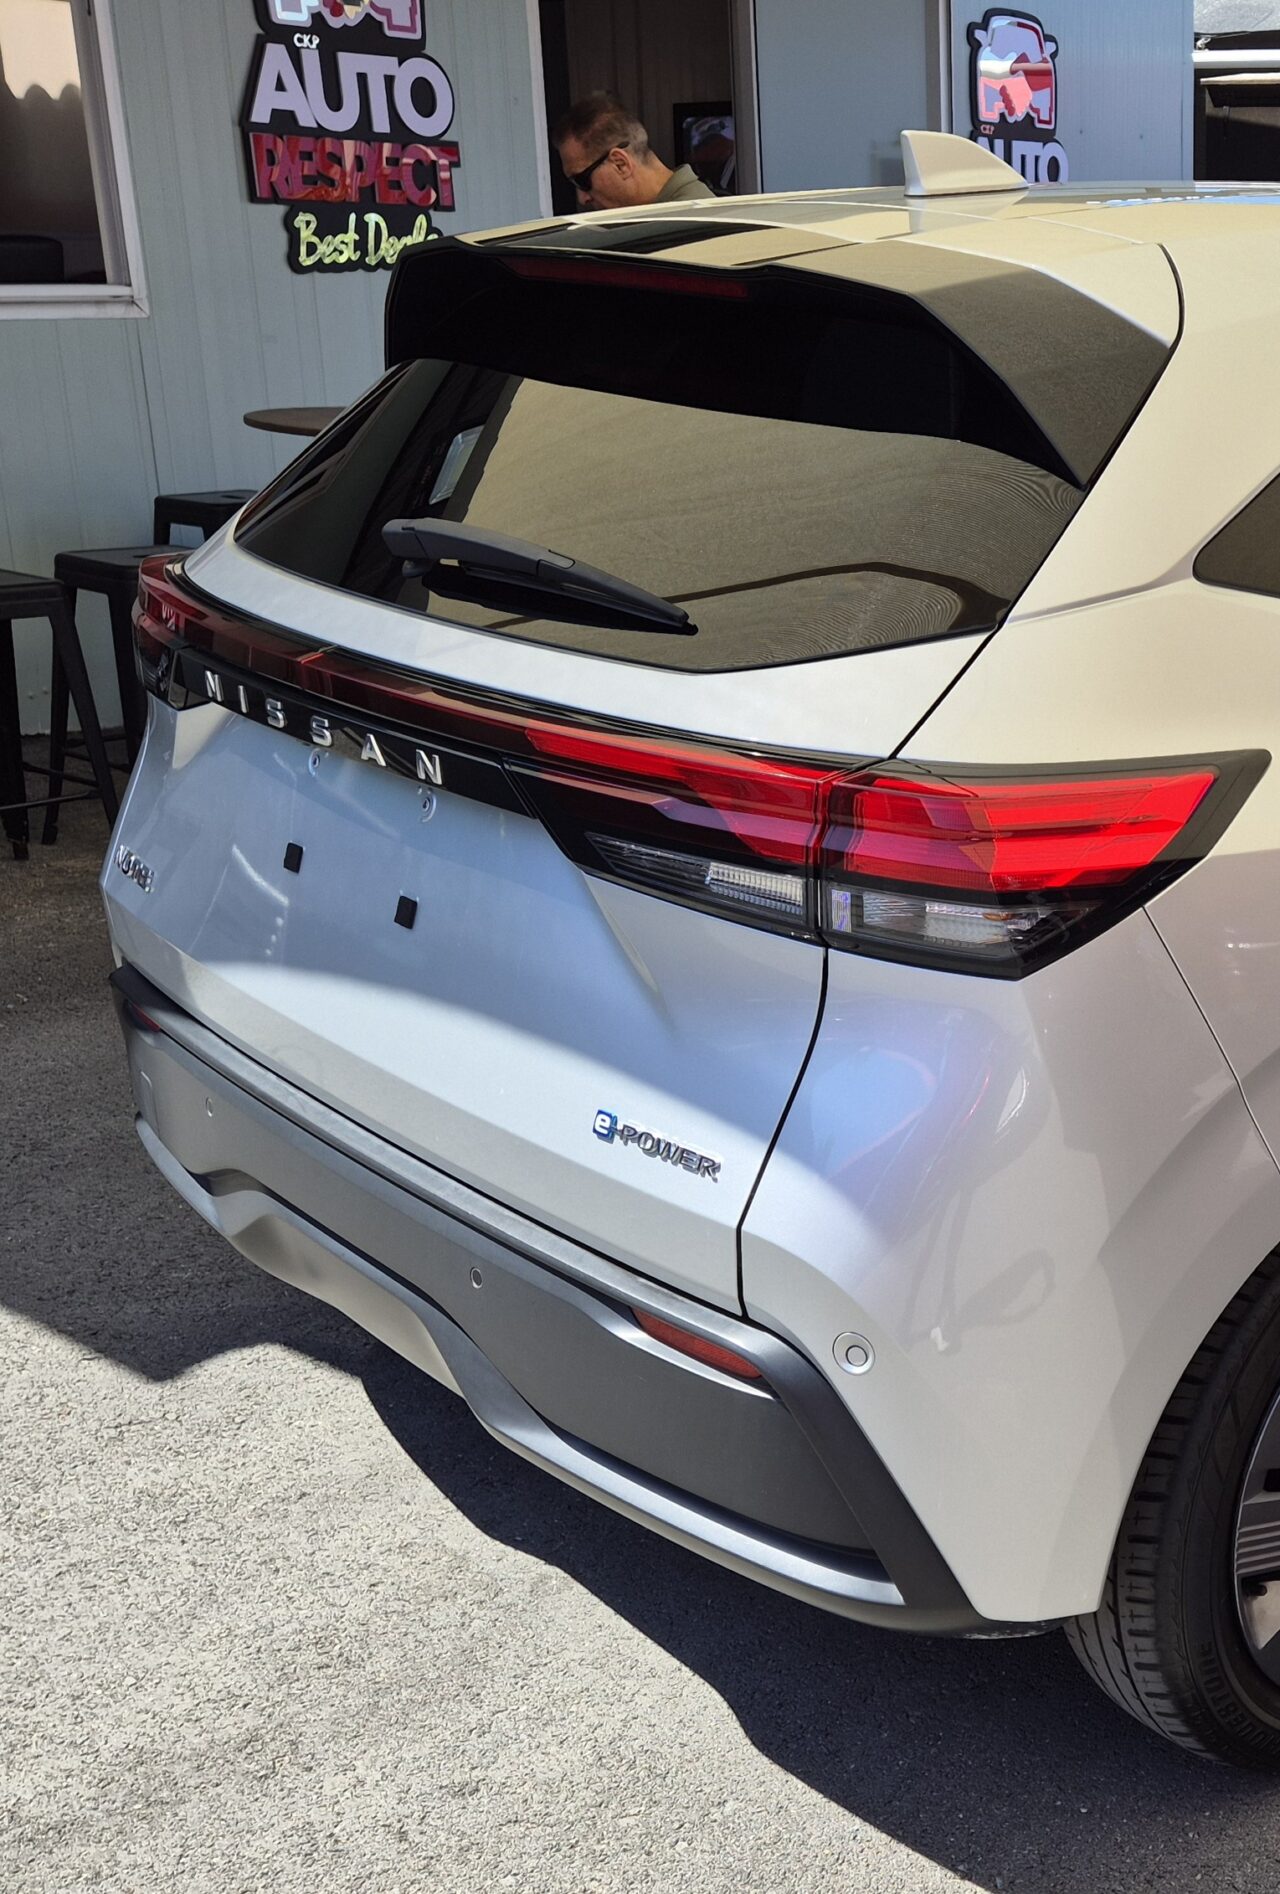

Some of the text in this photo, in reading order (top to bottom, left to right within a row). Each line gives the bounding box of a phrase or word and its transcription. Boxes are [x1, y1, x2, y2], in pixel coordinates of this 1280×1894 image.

[250, 42, 455, 138] AUTO
[250, 132, 460, 209] RESPECT
[976, 136, 1069, 185] UTO
[294, 212, 439, 266] Best Del
[204, 669, 443, 785] NISSAN
